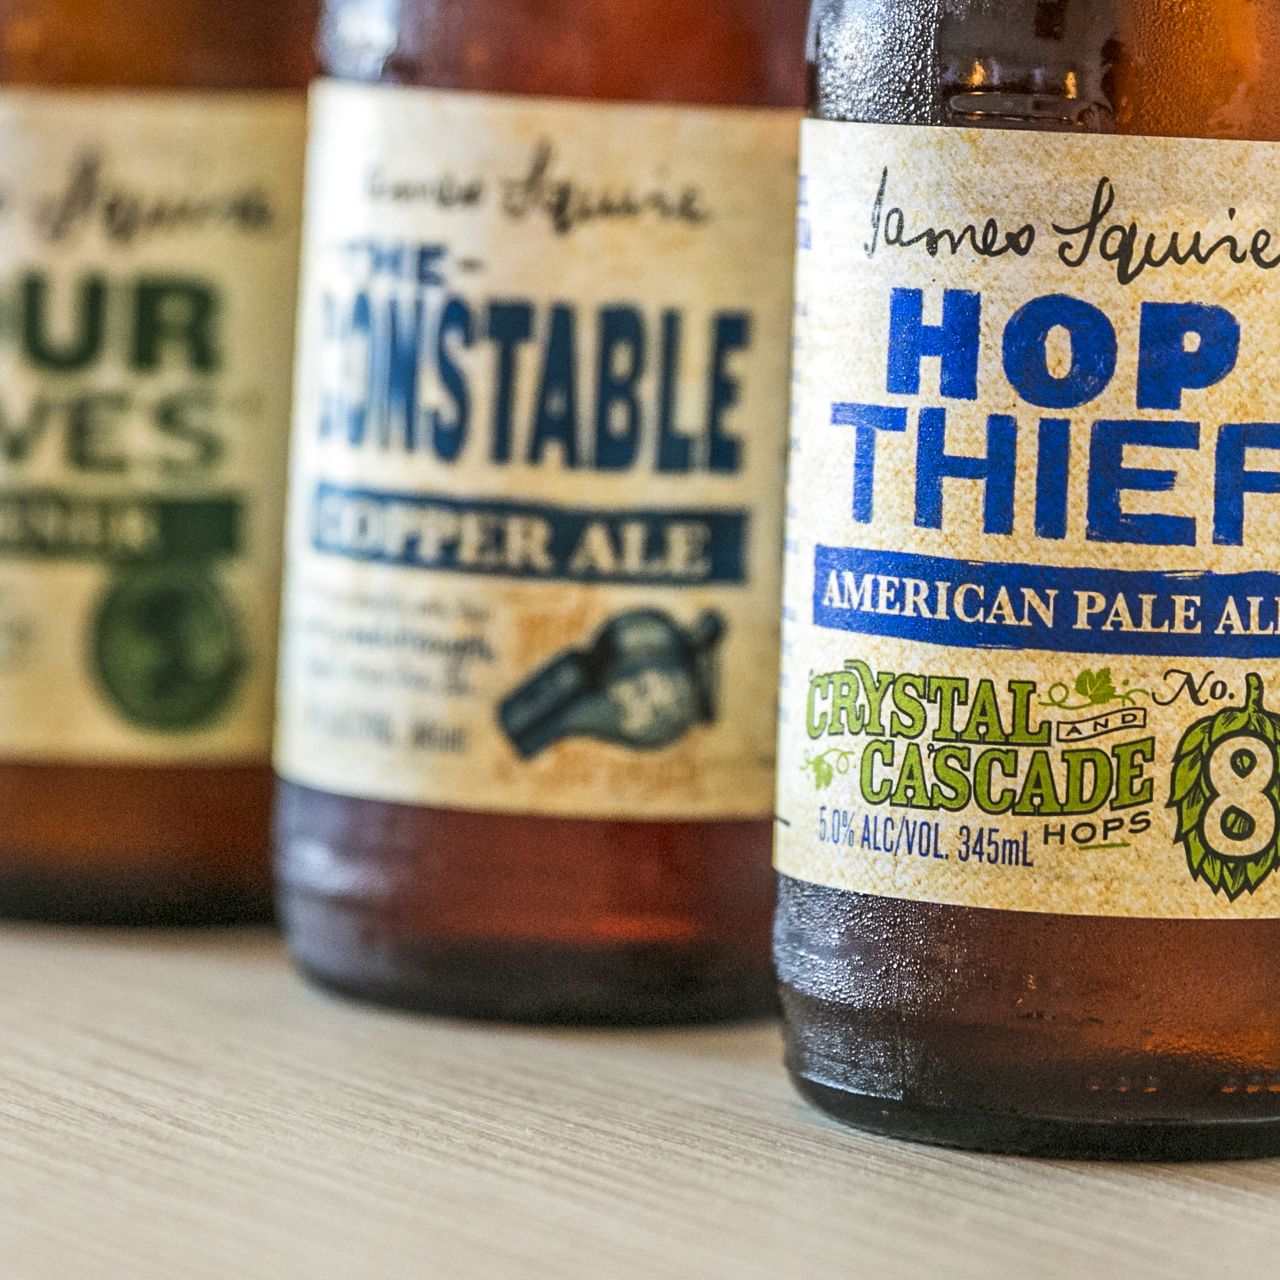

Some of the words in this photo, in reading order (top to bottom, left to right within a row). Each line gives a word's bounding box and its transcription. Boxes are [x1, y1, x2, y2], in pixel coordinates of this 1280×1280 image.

[863, 166, 1036, 260] James
[320, 288, 754, 476] ONSTABLE
[885, 287, 1241, 410] HOP
[570, 520, 712, 576] ALE
[821, 569, 1059, 629] AMERICAN
[1072, 590, 1202, 637] PALE
[805, 658, 1052, 747] CRYSTAL
[1065, 711, 1138, 737] AND
[1150, 668, 1236, 708] No.
[859, 736, 1156, 817] CASCADE
[1198, 732, 1280, 859] 8
[817, 805, 855, 847] 5.0%
[860, 813, 949, 860] ALC/VOL.
[957, 824, 1034, 868] 345mL
[1042, 810, 1152, 846] HOPS
